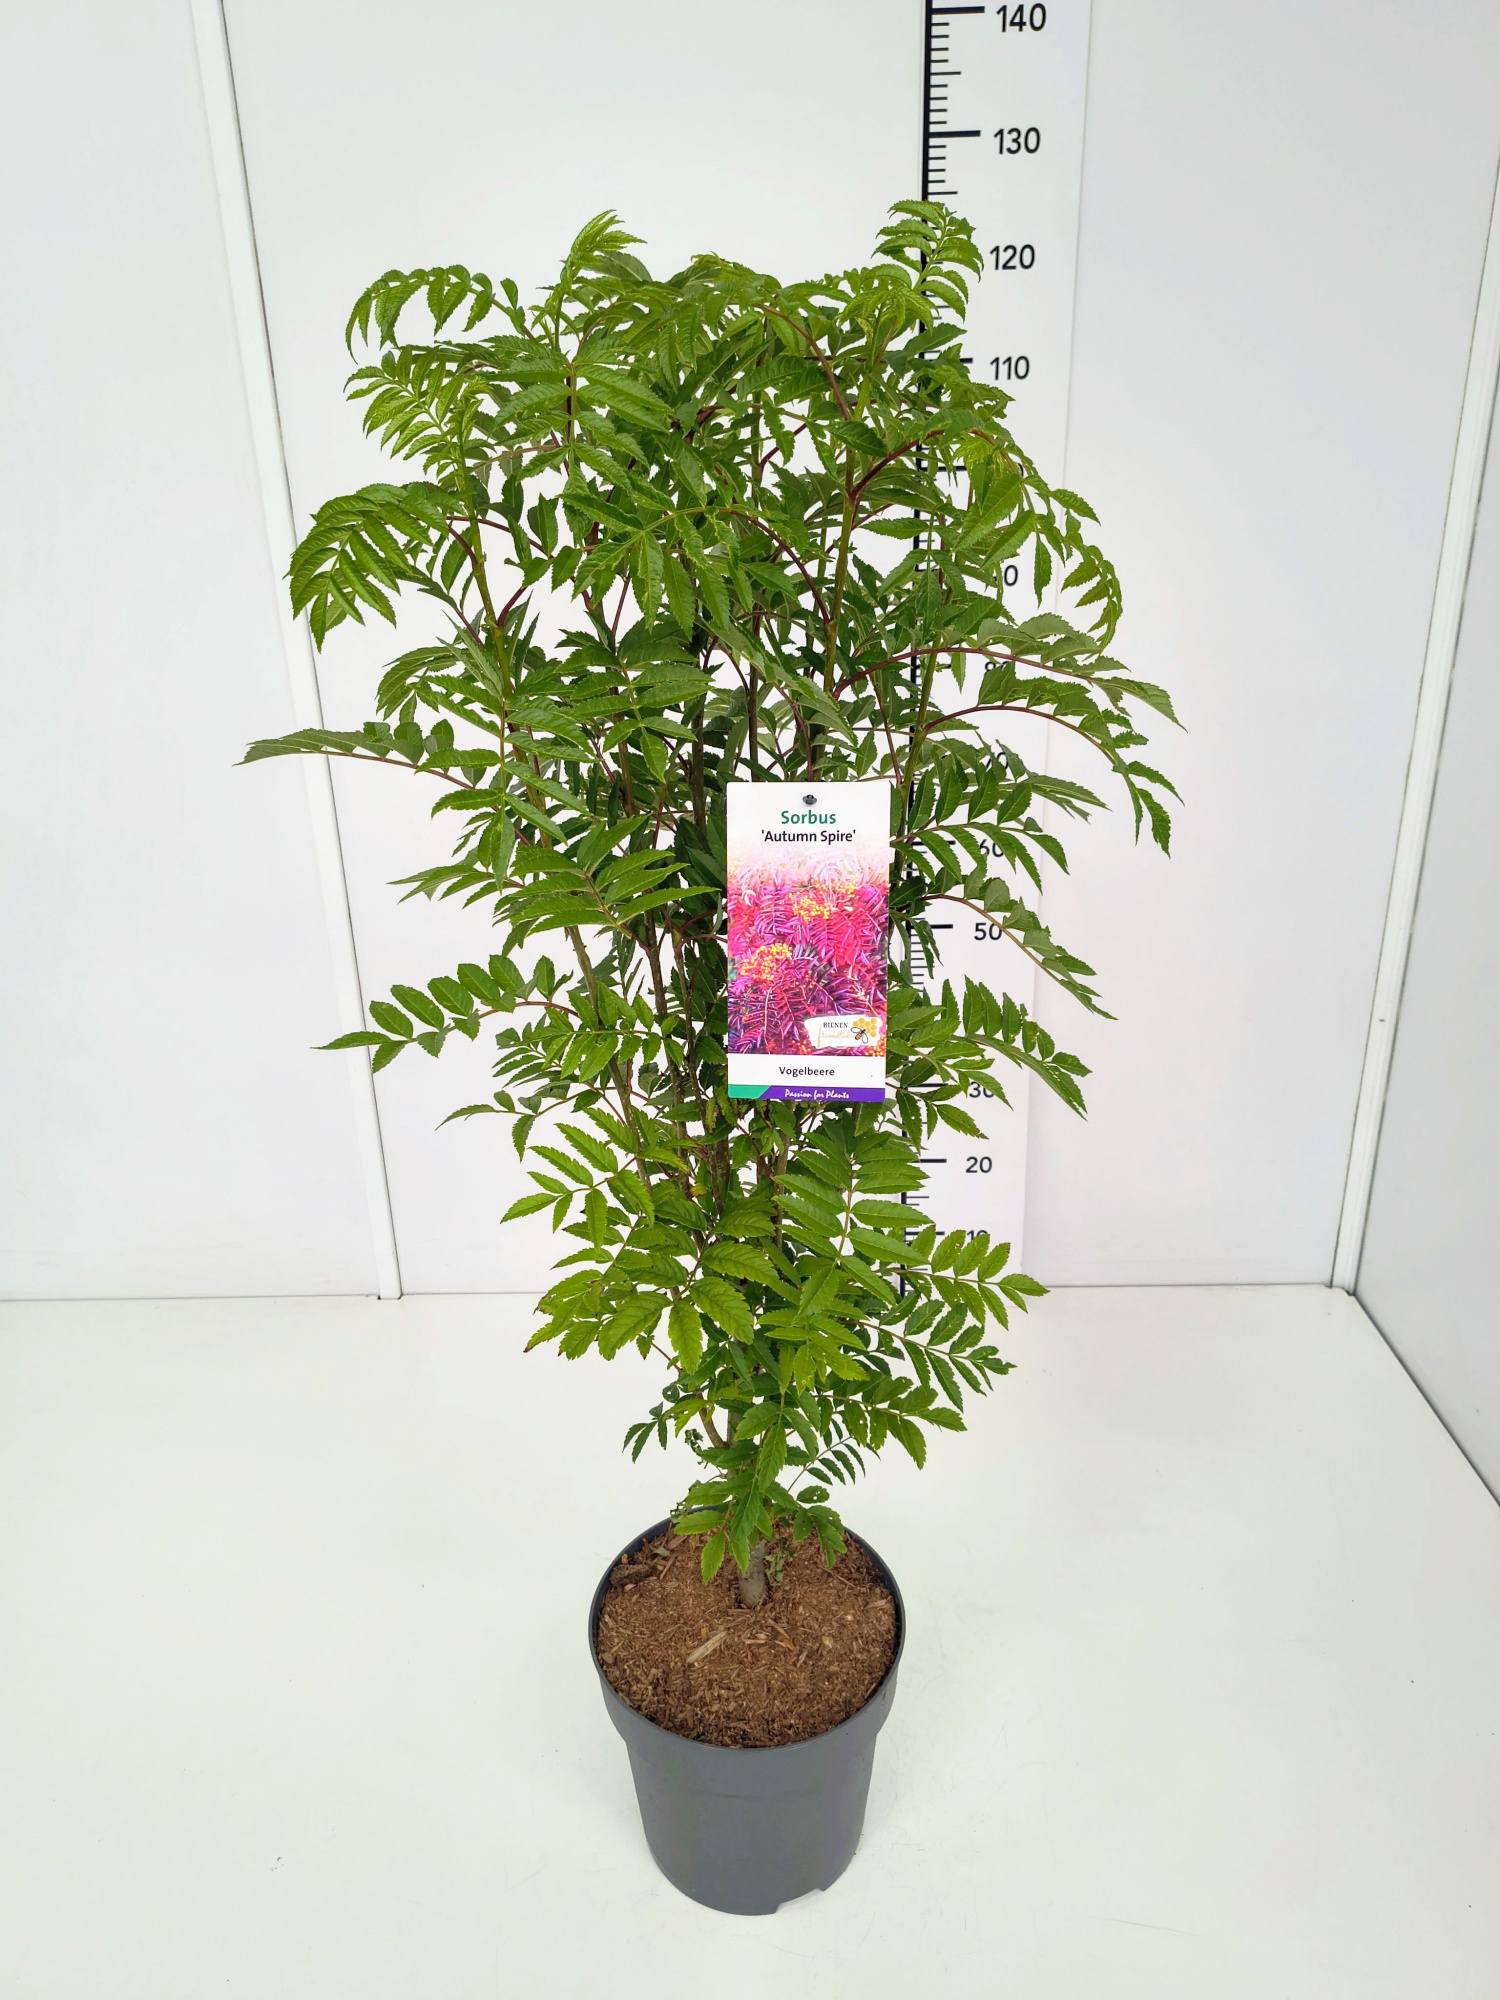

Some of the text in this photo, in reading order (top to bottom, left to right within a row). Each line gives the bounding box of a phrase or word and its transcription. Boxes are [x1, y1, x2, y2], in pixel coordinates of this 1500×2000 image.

[996, 3, 1046, 32] 140
[994, 127, 1041, 154] 130
[989, 244, 1035, 270] 120
[990, 355, 1030, 380] 110
[992, 564, 1018, 587] 0
[781, 809, 837, 825] Sorbus
[761, 829, 856, 845] 'Autumn Spire'
[973, 922, 1002, 941] 50
[823, 1021, 848, 1029] BIENEN
[778, 1066, 835, 1078] Vogelbeere
[784, 1088, 850, 1100] Passion for Plants
[965, 1156, 993, 1173] 20
